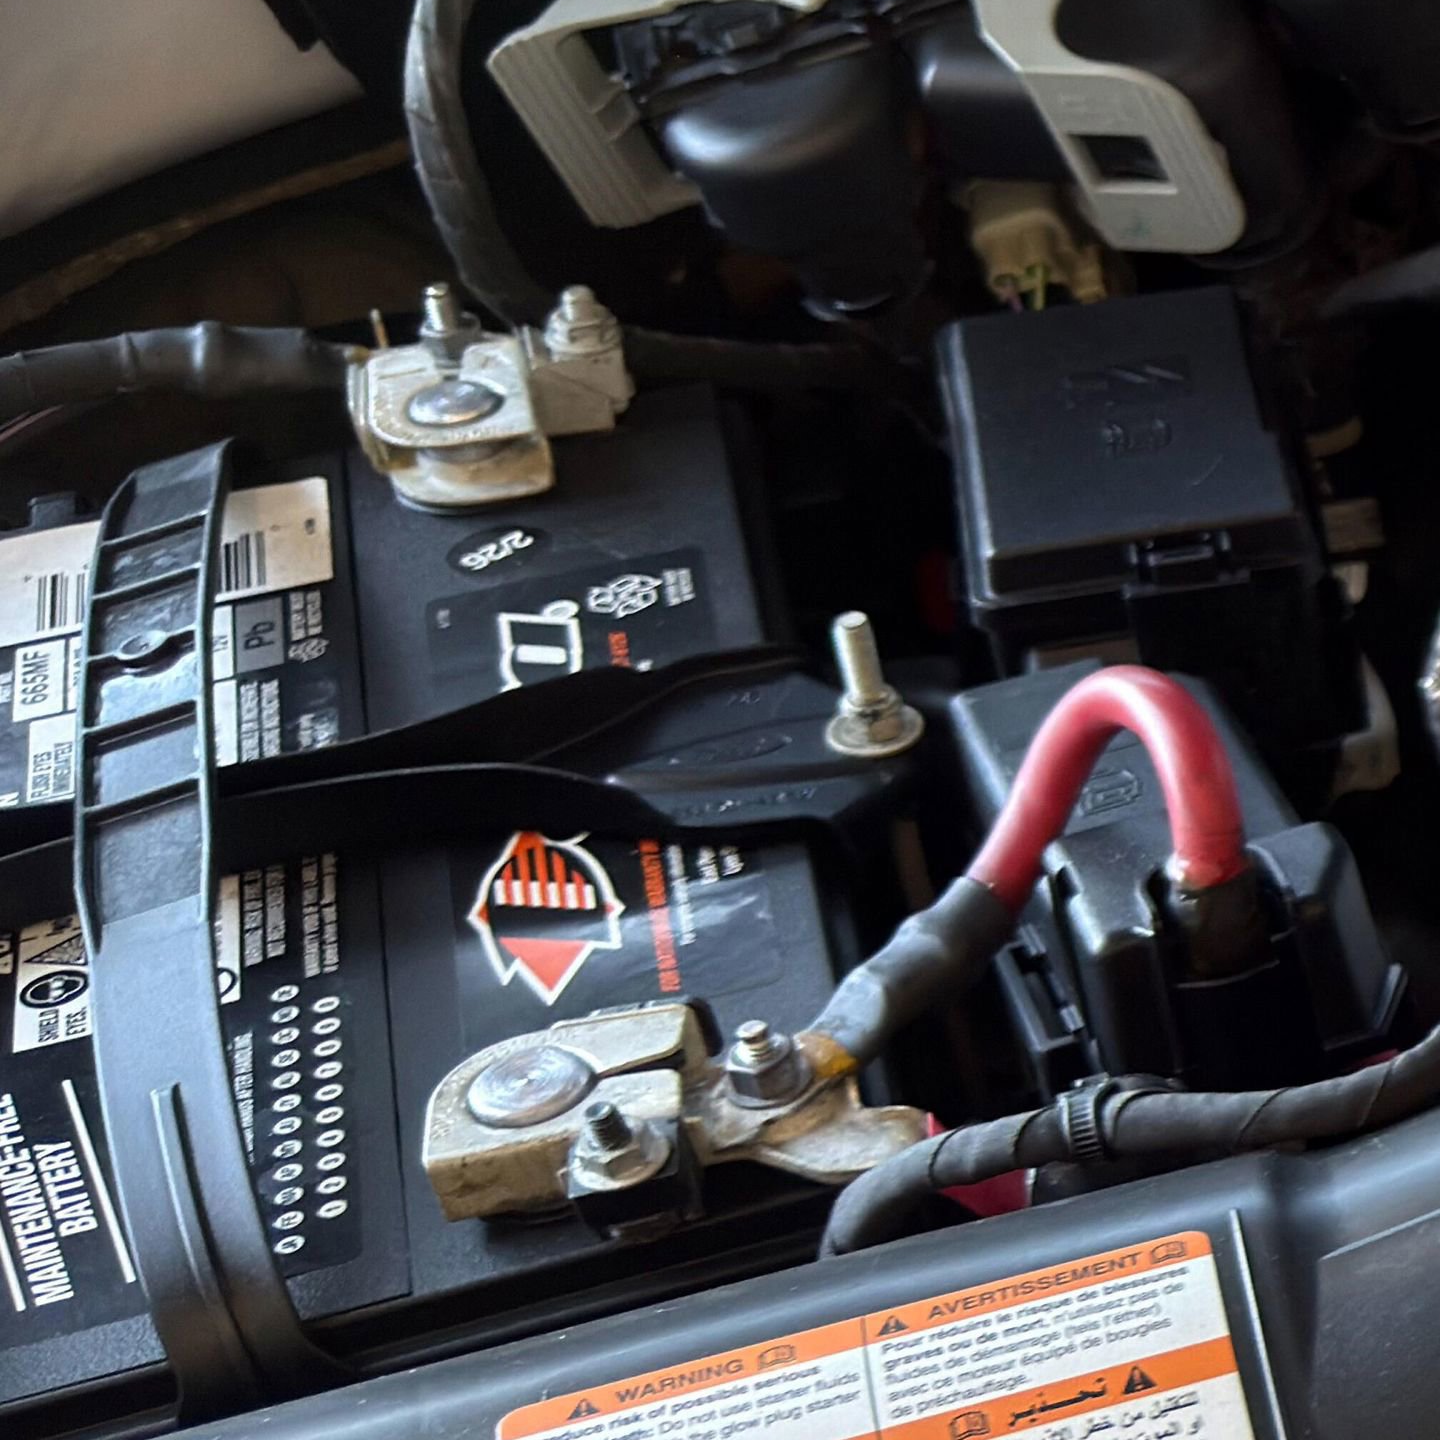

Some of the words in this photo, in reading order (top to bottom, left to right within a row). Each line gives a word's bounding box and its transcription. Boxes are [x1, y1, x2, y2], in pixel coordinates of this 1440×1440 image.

[459, 530, 534, 570] 2/26
[243, 622, 276, 650] Pb
[21, 650, 50, 706] 665MF
[32, 751, 52, 770] EYES
[33, 771, 52, 799] FLUSH
[37, 1008, 61, 1042] SHIELD
[64, 1007, 88, 1036] EYES.
[34, 1140, 98, 1237] BATTERY
[880, 1334, 924, 1356] Pour
[928, 1315, 992, 1343] réduire
[995, 1310, 1012, 1325] le
[1015, 1294, 1073, 1322] risque
[1076, 1287, 1099, 1303] de
[1102, 1263, 1188, 1296] blessures
[926, 1251, 1143, 1320] AVERTISSEMENT
[882, 1345, 945, 1373] graves
[948, 1338, 971, 1353] ou
[974, 1329, 998, 1345] de
[1001, 1316, 1048, 1339] mort,
[1051, 1295, 1125, 1325] n'utilisez
[1127, 1288, 1159, 1307] pas
[1162, 1279, 1185, 1295] de
[884, 1361, 940, 1387] fluides
[943, 1353, 966, 1371] de
[970, 1328, 1062, 1366] démarrage
[1063, 1317, 1102, 1339] (tels
[1103, 1301, 1161, 1329] l'éther)
[615, 1357, 744, 1404] WARNING
[888, 1383, 928, 1402] avec
[932, 1376, 952, 1390] ce
[956, 1356, 1017, 1383] moteur
[1019, 1340, 1078, 1369] équipé
[1080, 1333, 1102, 1350] de
[1105, 1314, 1173, 1346] bougies
[608, 1410, 643, 1430] risk
[646, 1403, 667, 1419] of
[670, 1381, 748, 1416] possible
[753, 1362, 820, 1391] serious
[657, 1417, 682, 1435] Do
[687, 1408, 717, 1427] not
[721, 1401, 750, 1418] use
[755, 1383, 809, 1408] starter
[813, 1369, 860, 1393] fluids
[719, 1415, 760, 1439] glow
[763, 1404, 801, 1427] plug
[805, 1388, 860, 1414] starter
[890, 1402, 912, 1419] de
[917, 1370, 1030, 1415] préchauffage.
